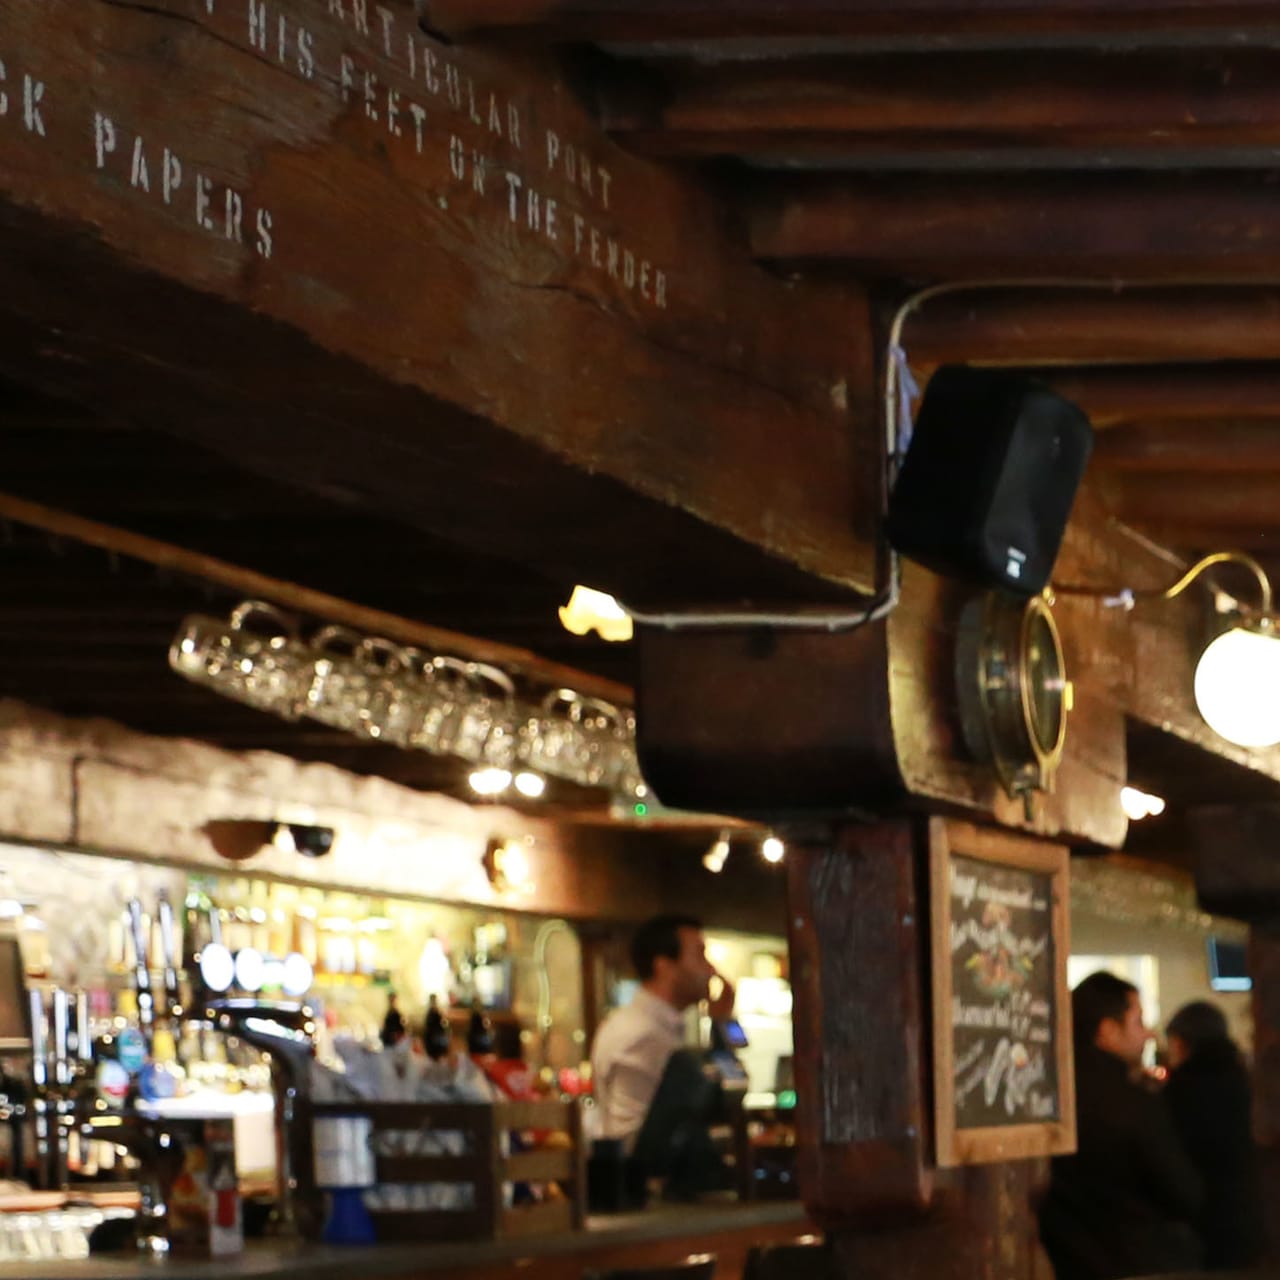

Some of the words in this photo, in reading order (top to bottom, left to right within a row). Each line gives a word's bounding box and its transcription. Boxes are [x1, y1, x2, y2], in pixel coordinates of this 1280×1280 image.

[94, 111, 273, 260] PAPERS
[248, 0, 313, 78] HIS
[340, 54, 427, 153] FEET
[450, 134, 485, 197] ON
[505, 171, 558, 241] THE
[573, 212, 667, 309] FENDER
[547, 128, 611, 209] PORT
